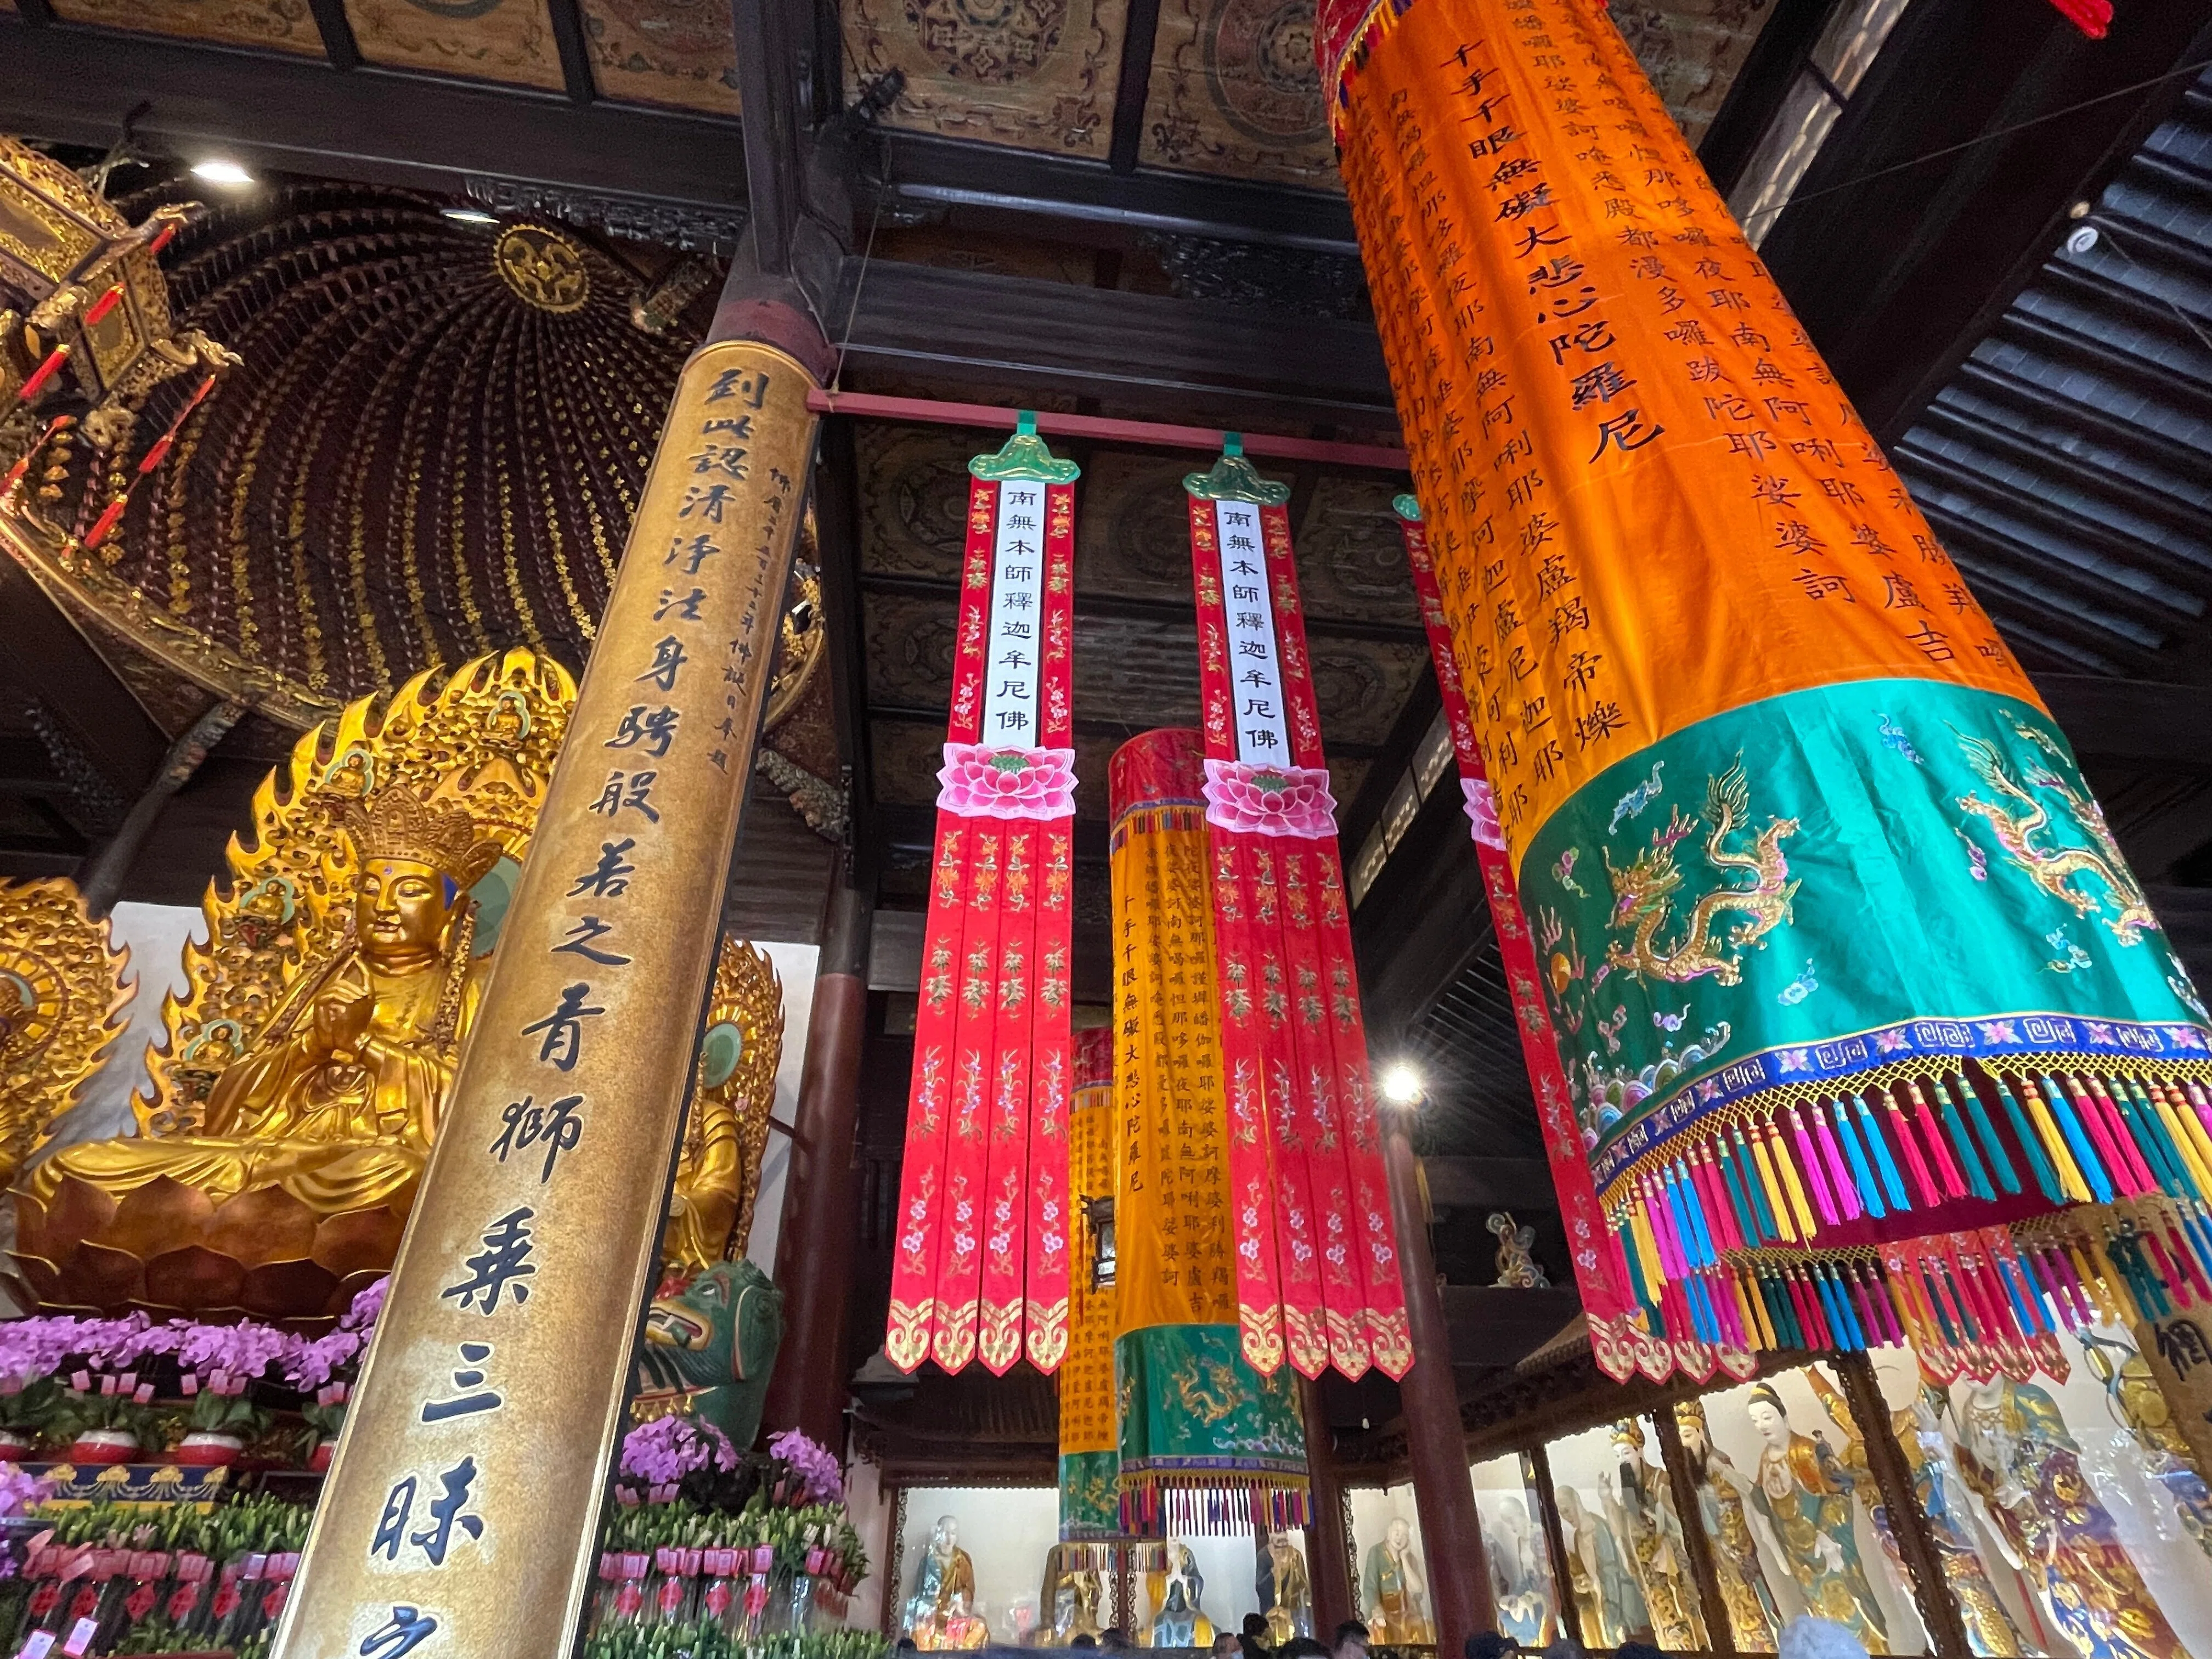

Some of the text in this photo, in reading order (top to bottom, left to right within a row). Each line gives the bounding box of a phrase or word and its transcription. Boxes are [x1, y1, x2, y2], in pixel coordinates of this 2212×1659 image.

[1440, 40, 1666, 465] 千手千眼無礙大悲心陀羅尼
[995, 490, 1037, 731] 南無本師釋迦牟尼佛
[1223, 511, 1278, 750] 南無本師釋迦牟尼佛
